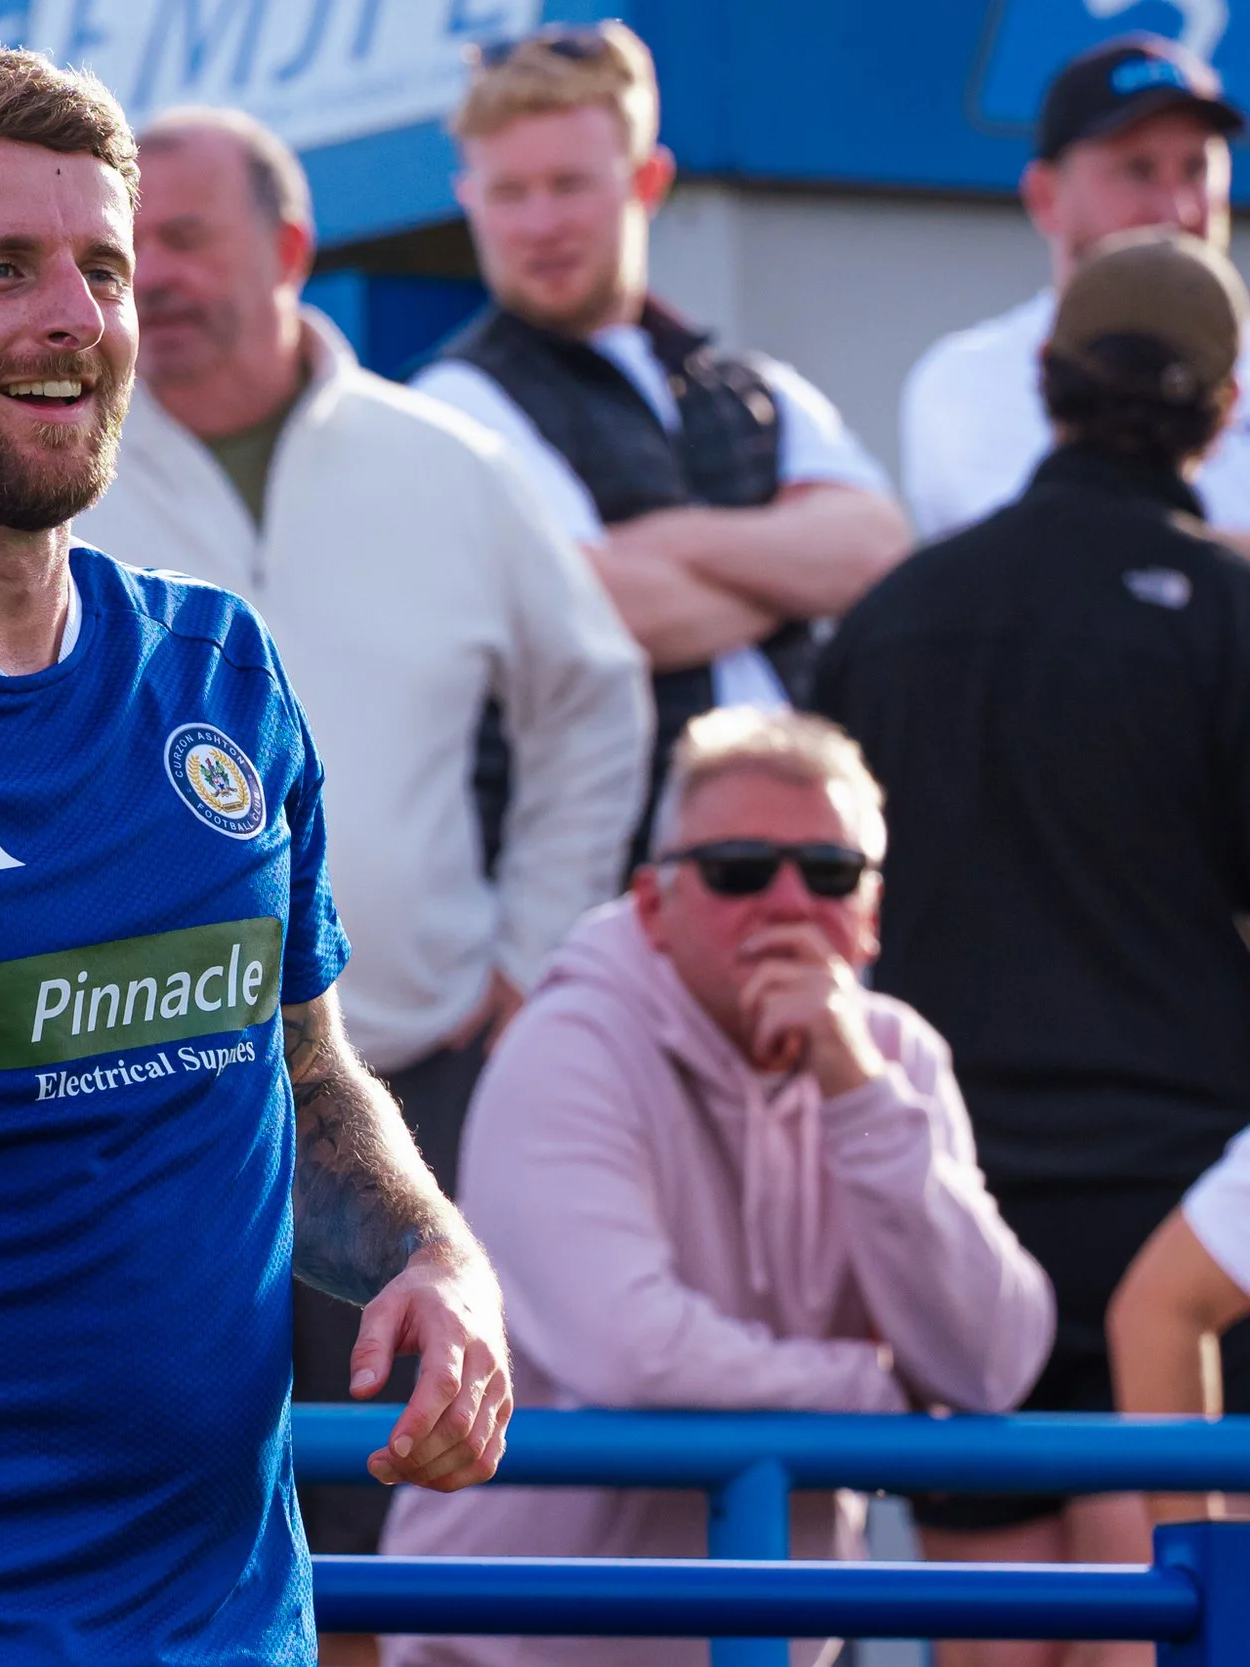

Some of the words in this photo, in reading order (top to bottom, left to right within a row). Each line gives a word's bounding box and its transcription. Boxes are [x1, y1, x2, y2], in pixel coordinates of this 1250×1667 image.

[173, 734, 194, 778] CURZON
[197, 731, 245, 765] ASHTON
[196, 802, 254, 831] FOOTBALL
[252, 791, 261, 822] CLUB
[31, 943, 263, 1043] Pinnacle
[35, 1052, 176, 1101] Electrical
[177, 1041, 256, 1080] Supes
